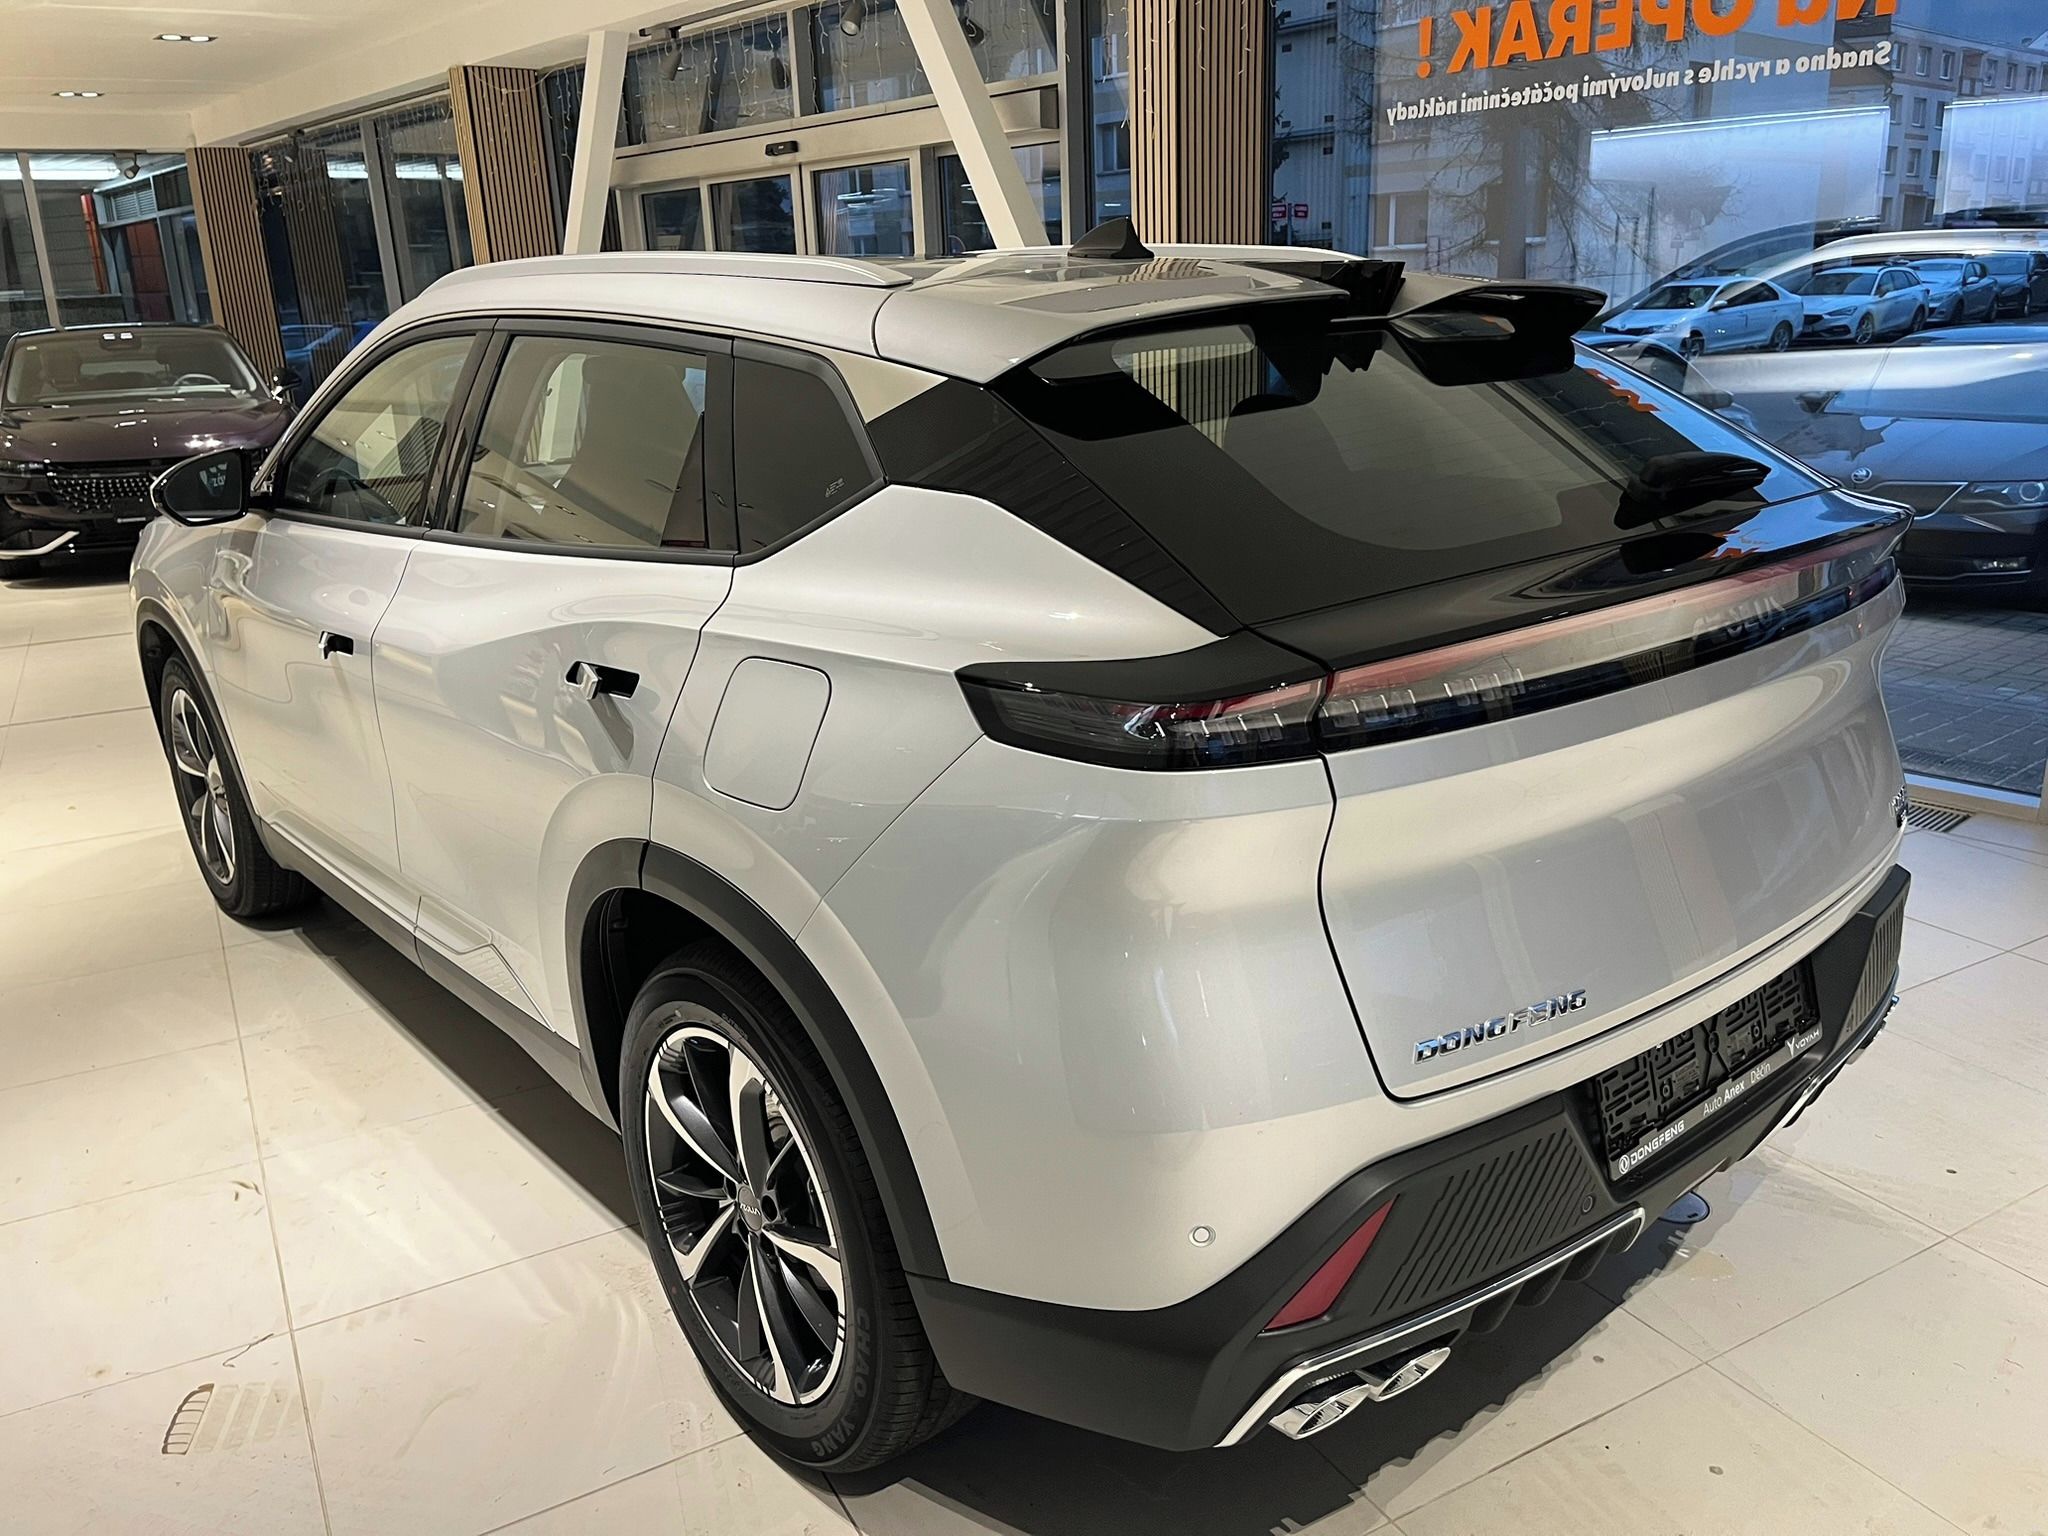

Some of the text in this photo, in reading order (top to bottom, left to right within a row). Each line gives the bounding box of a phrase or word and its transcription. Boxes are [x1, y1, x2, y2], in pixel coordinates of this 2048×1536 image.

[1411, 988, 1588, 1065] DONGFENG
[1630, 1119, 1685, 1166] DONGFENG
[1702, 1096, 1722, 1117] Auto
[1723, 1081, 1745, 1103] Anex
[1750, 1063, 1771, 1084] Děčín
